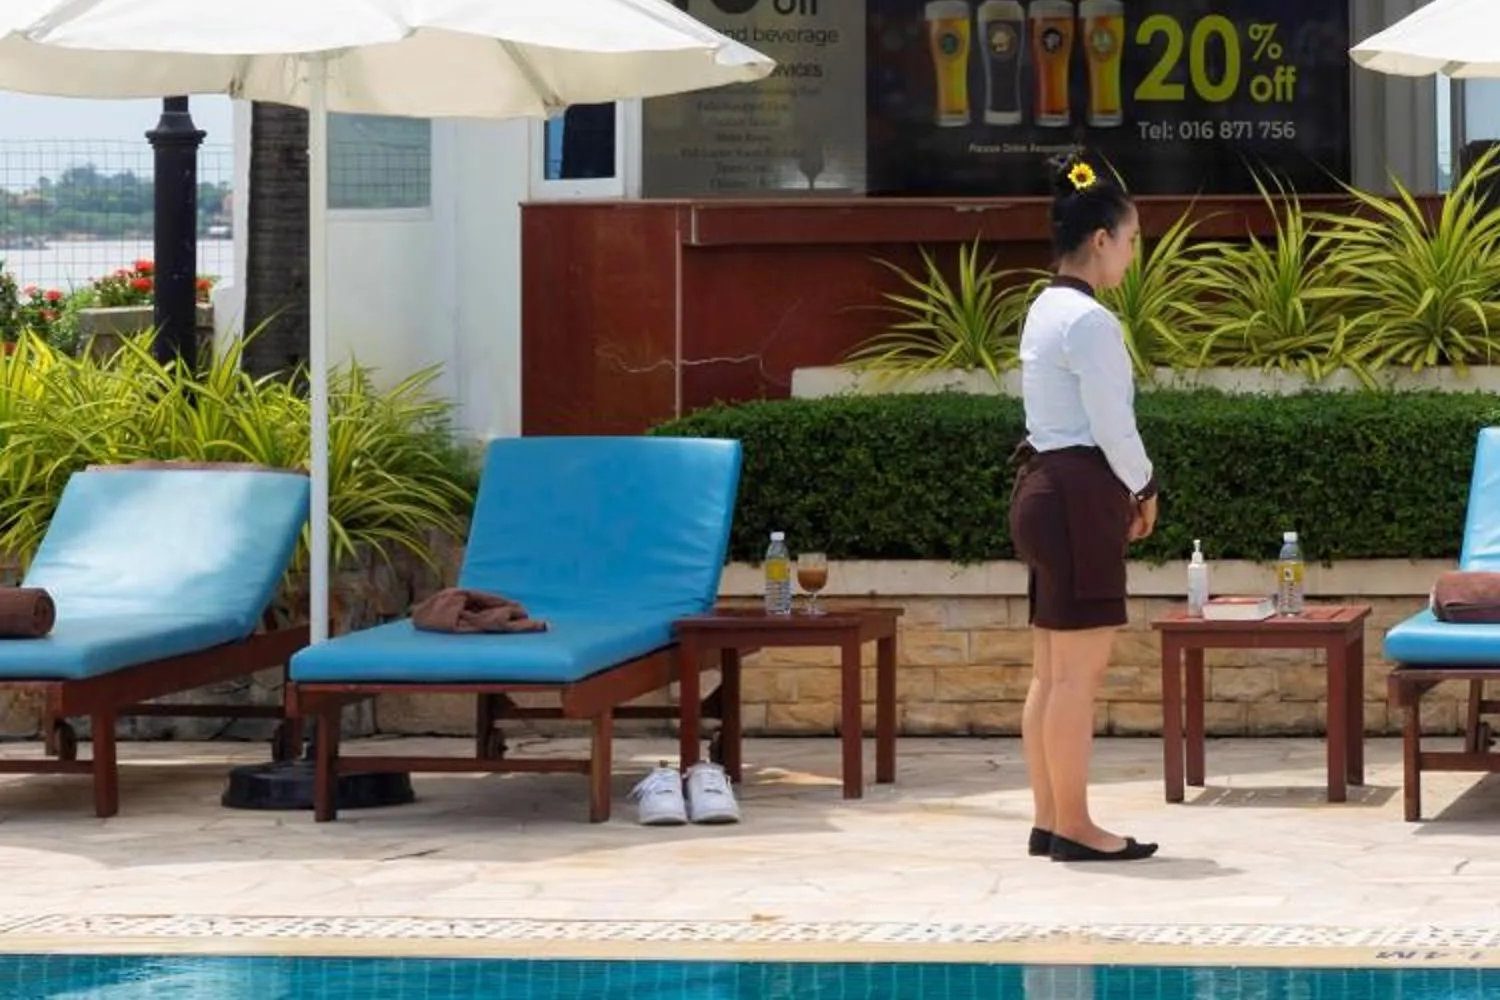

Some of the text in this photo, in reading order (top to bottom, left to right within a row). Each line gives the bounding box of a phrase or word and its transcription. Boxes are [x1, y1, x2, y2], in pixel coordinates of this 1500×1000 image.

[753, 27, 840, 47] beverage
[1250, 65, 1296, 102] off
[1138, 121, 1296, 140] Tel: 016 871 756
